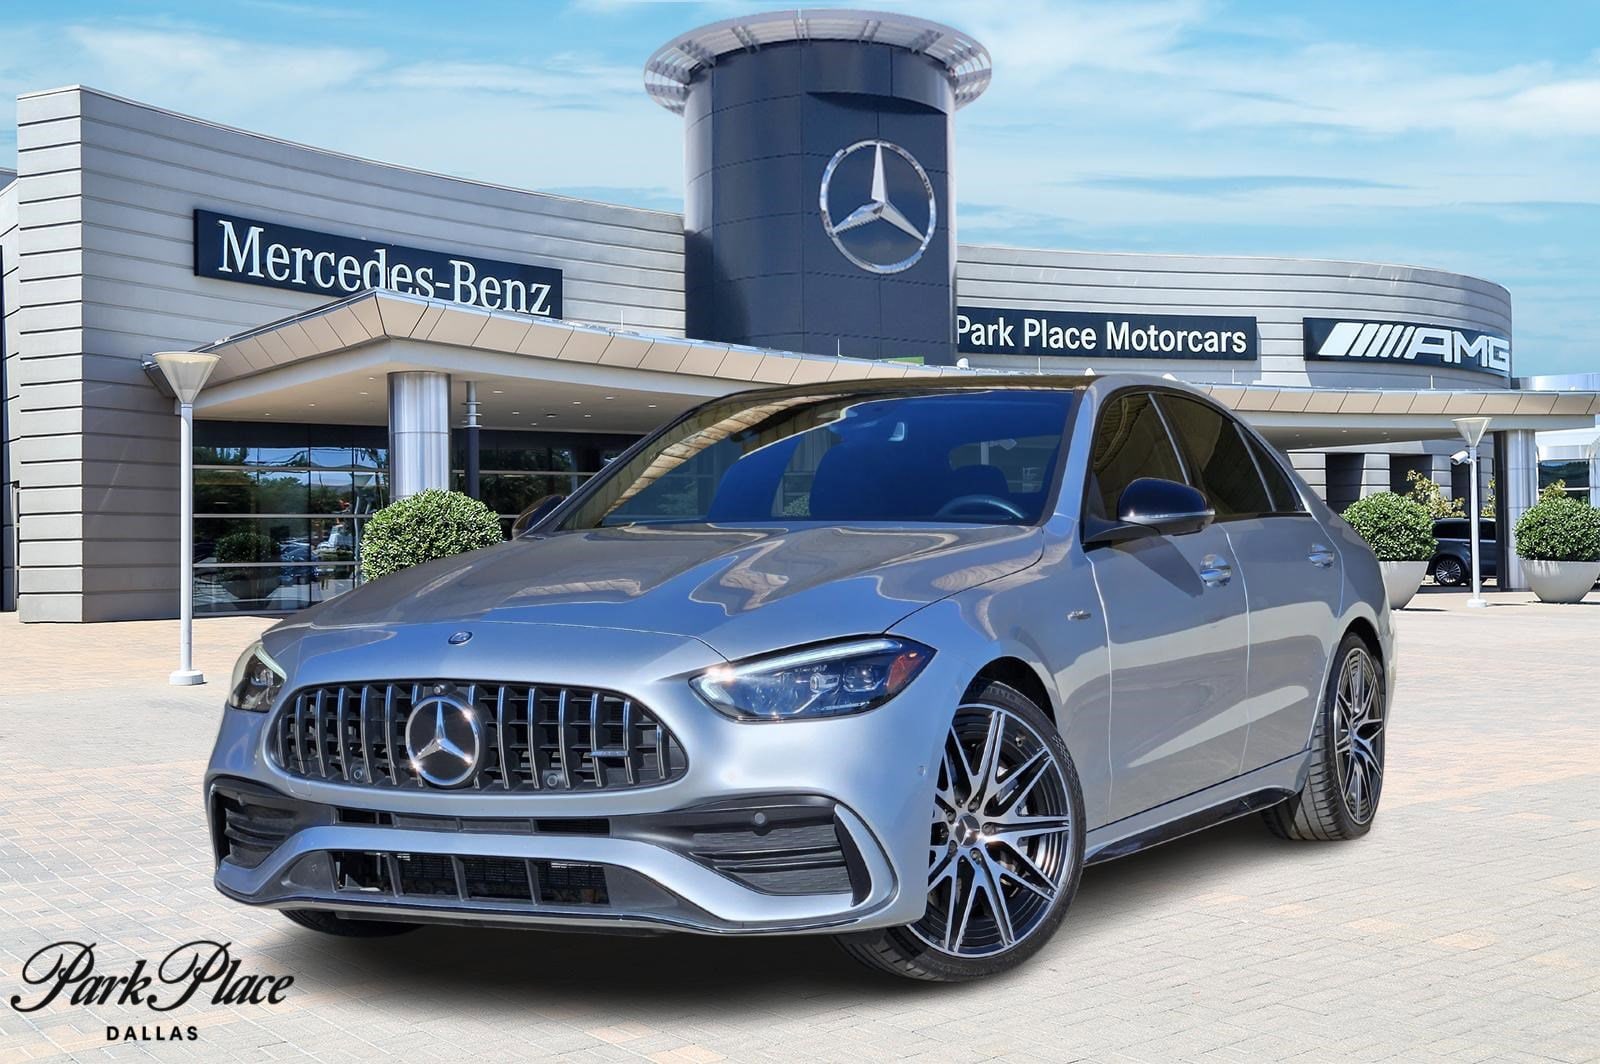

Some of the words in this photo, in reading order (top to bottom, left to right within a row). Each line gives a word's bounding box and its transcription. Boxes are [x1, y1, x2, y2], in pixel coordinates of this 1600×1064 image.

[217, 219, 552, 316] Mercedes-Benz
[957, 315, 1015, 347] Park
[1023, 318, 1097, 350] Place
[1106, 321, 1247, 353] Motorcars
